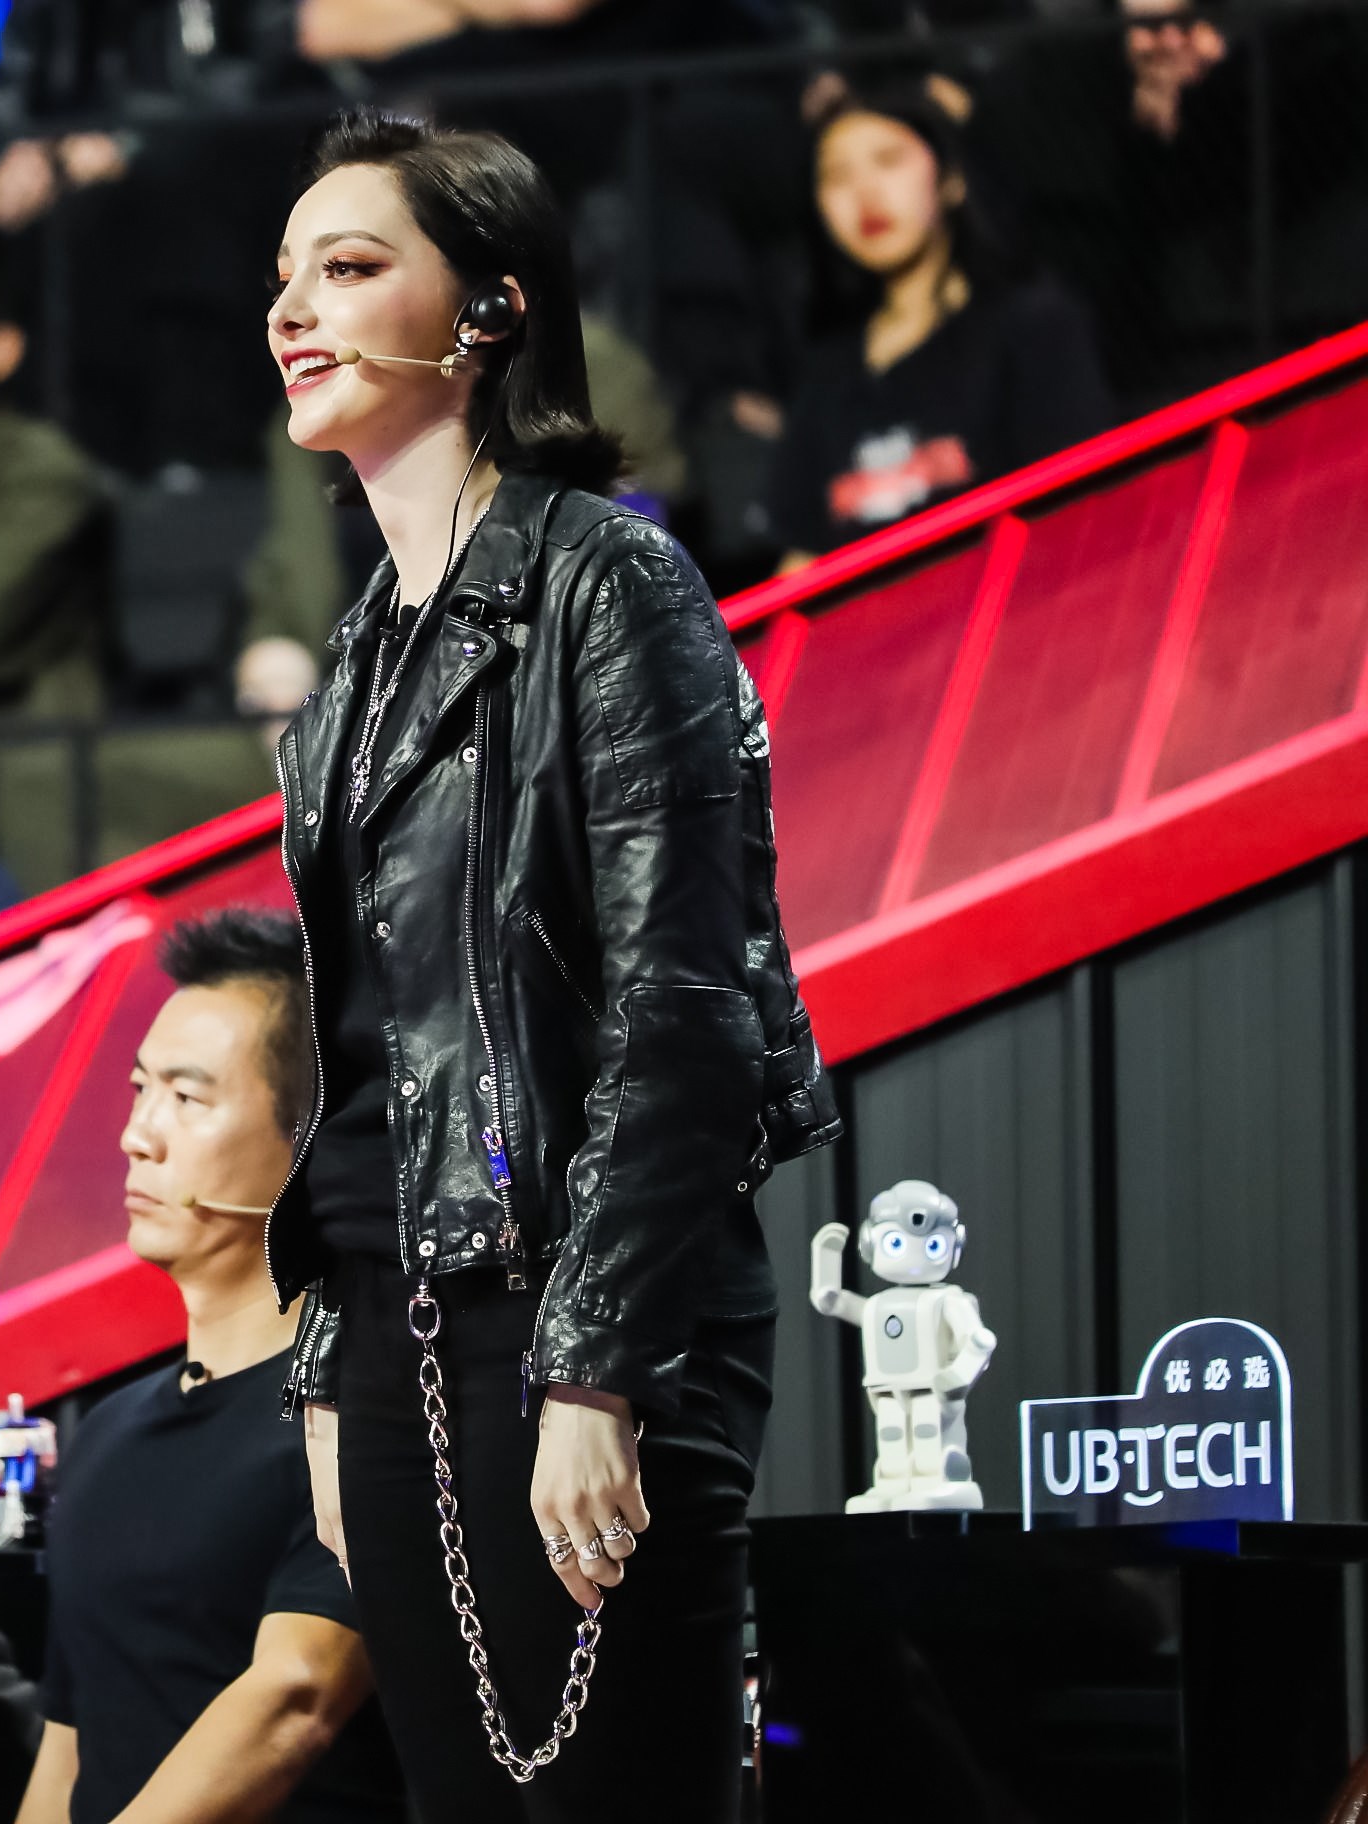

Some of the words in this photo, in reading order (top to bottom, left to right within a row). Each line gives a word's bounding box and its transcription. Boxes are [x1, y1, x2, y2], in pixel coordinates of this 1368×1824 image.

[1164, 1355, 1271, 1394] 优必选
[1042, 1420, 1272, 1499] UBTECH
